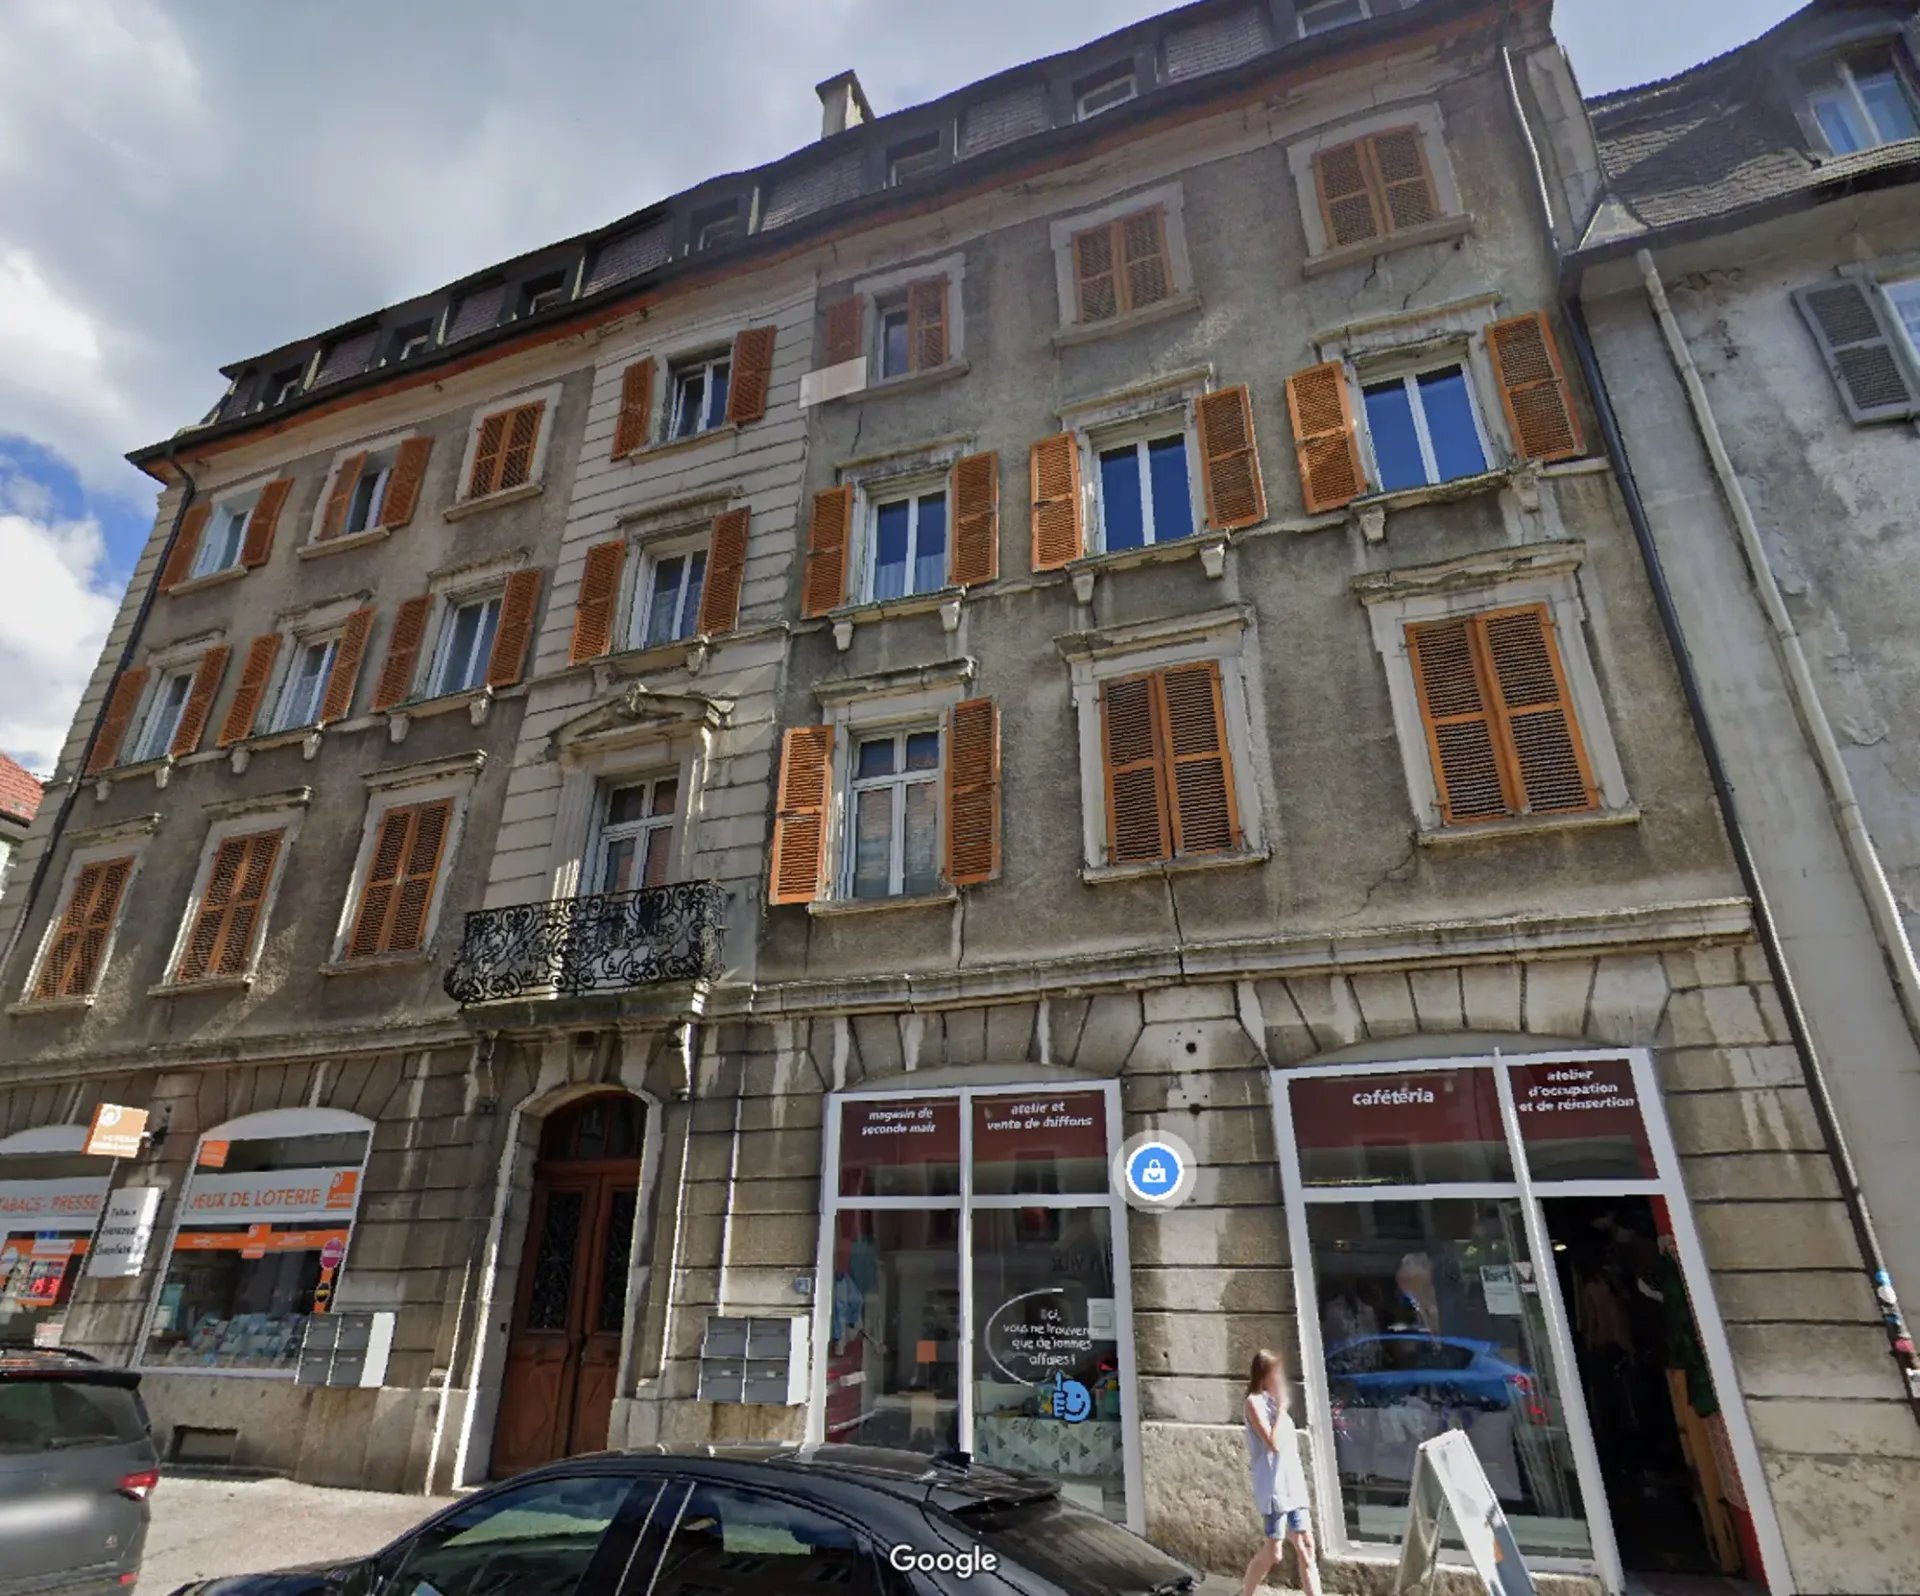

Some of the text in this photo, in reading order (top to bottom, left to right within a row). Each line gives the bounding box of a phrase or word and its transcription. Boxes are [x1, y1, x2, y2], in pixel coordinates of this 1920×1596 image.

[1547, 1069, 1594, 1081] atelier
[1352, 1087, 1434, 1105] cafétéria
[1051, 1101, 1065, 1112] et
[1519, 1096, 1635, 1112] et de réinsertion
[868, 1106, 933, 1122] magasin de
[861, 1122, 908, 1135] seconde
[986, 1119, 1022, 1130] vente
[1024, 1117, 1040, 1129] de
[50, 1193, 101, 1211] PRESSE
[189, 1192, 227, 1210] JEUX
[229, 1191, 251, 1208] DE
[253, 1188, 322, 1208] LOTERIE
[1003, 1324, 1028, 1333] vous
[1030, 1325, 1045, 1335] ne
[1012, 1339, 1034, 1350] que
